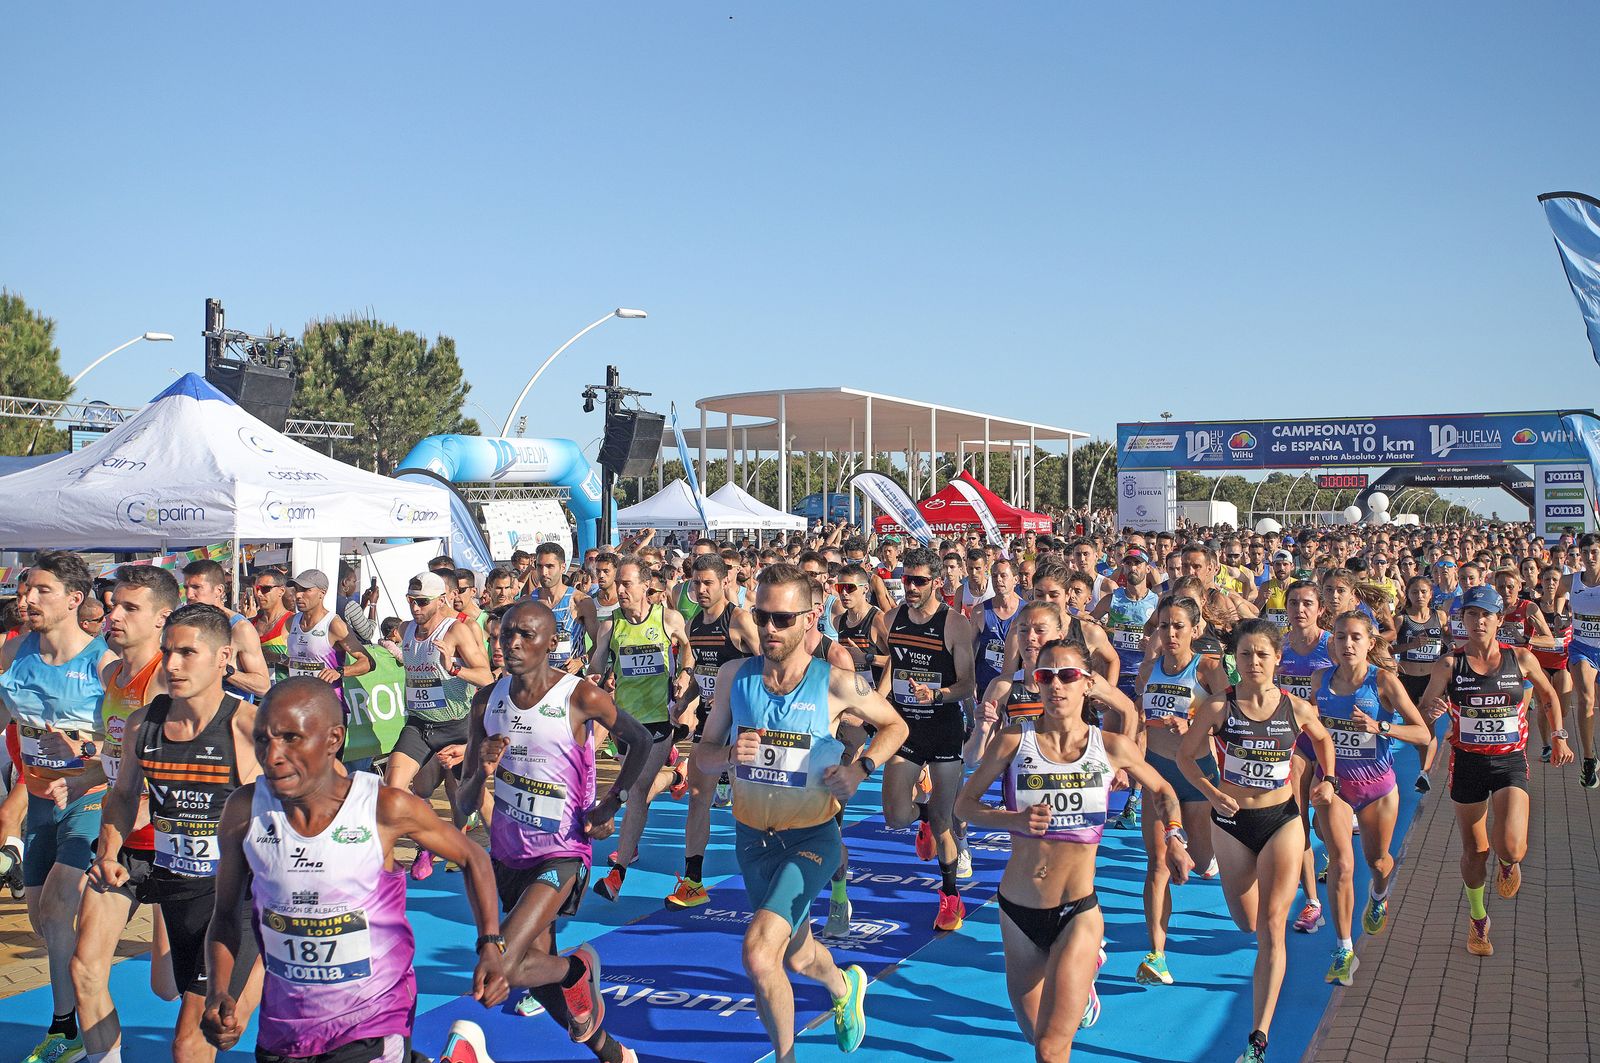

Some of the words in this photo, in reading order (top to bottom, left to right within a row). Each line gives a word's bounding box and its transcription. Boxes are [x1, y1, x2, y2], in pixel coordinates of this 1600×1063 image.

[1272, 423, 1376, 437] CAMPEONATO
[1541, 430, 1574, 442] WiH
[1456, 430, 1502, 443] HUELVA
[1271, 442, 1287, 452] de
[1291, 438, 1343, 452] ESPAÑA
[1352, 437, 1376, 452] 10
[1382, 435, 1415, 451] km
[516, 447, 549, 464] HUELVA
[1340, 452, 1376, 461] Absoluto
[1378, 453, 1384, 462] y
[1385, 452, 1415, 460] Master
[1580, 622, 1600, 632] 404
[1122, 633, 1141, 643] 163
[631, 655, 655, 667] 172
[909, 652, 932, 661] VICKY
[416, 689, 429, 700] 48
[1485, 696, 1506, 705] BM
[791, 702, 816, 712] HOKA
[1151, 694, 1176, 709] 408
[1474, 720, 1505, 733] 432
[762, 731, 802, 741] RUNNING
[1332, 733, 1360, 747] 426
[771, 739, 794, 747] LOOP
[1255, 740, 1275, 749] BM
[764, 748, 776, 766] 9
[1335, 747, 1361, 757] oma
[1241, 762, 1274, 778] 402
[1049, 773, 1093, 781] RUNNING
[519, 777, 560, 790] RUNNING
[171, 790, 214, 803] VICKY
[527, 787, 551, 796] LOOP
[176, 801, 210, 810] FOODS
[514, 792, 536, 812] 11
[1040, 792, 1083, 812] 409
[176, 821, 218, 829] RUNNIN
[1048, 814, 1085, 827] oma
[187, 829, 214, 837] LOOP
[256, 836, 281, 844] VIATOR
[168, 837, 210, 858] 152
[314, 905, 348, 914] ALBACETE
[291, 913, 352, 927] RUNNING
[306, 926, 343, 936] LOOP
[283, 938, 337, 963] 187
[600, 985, 760, 1020] Huelv
